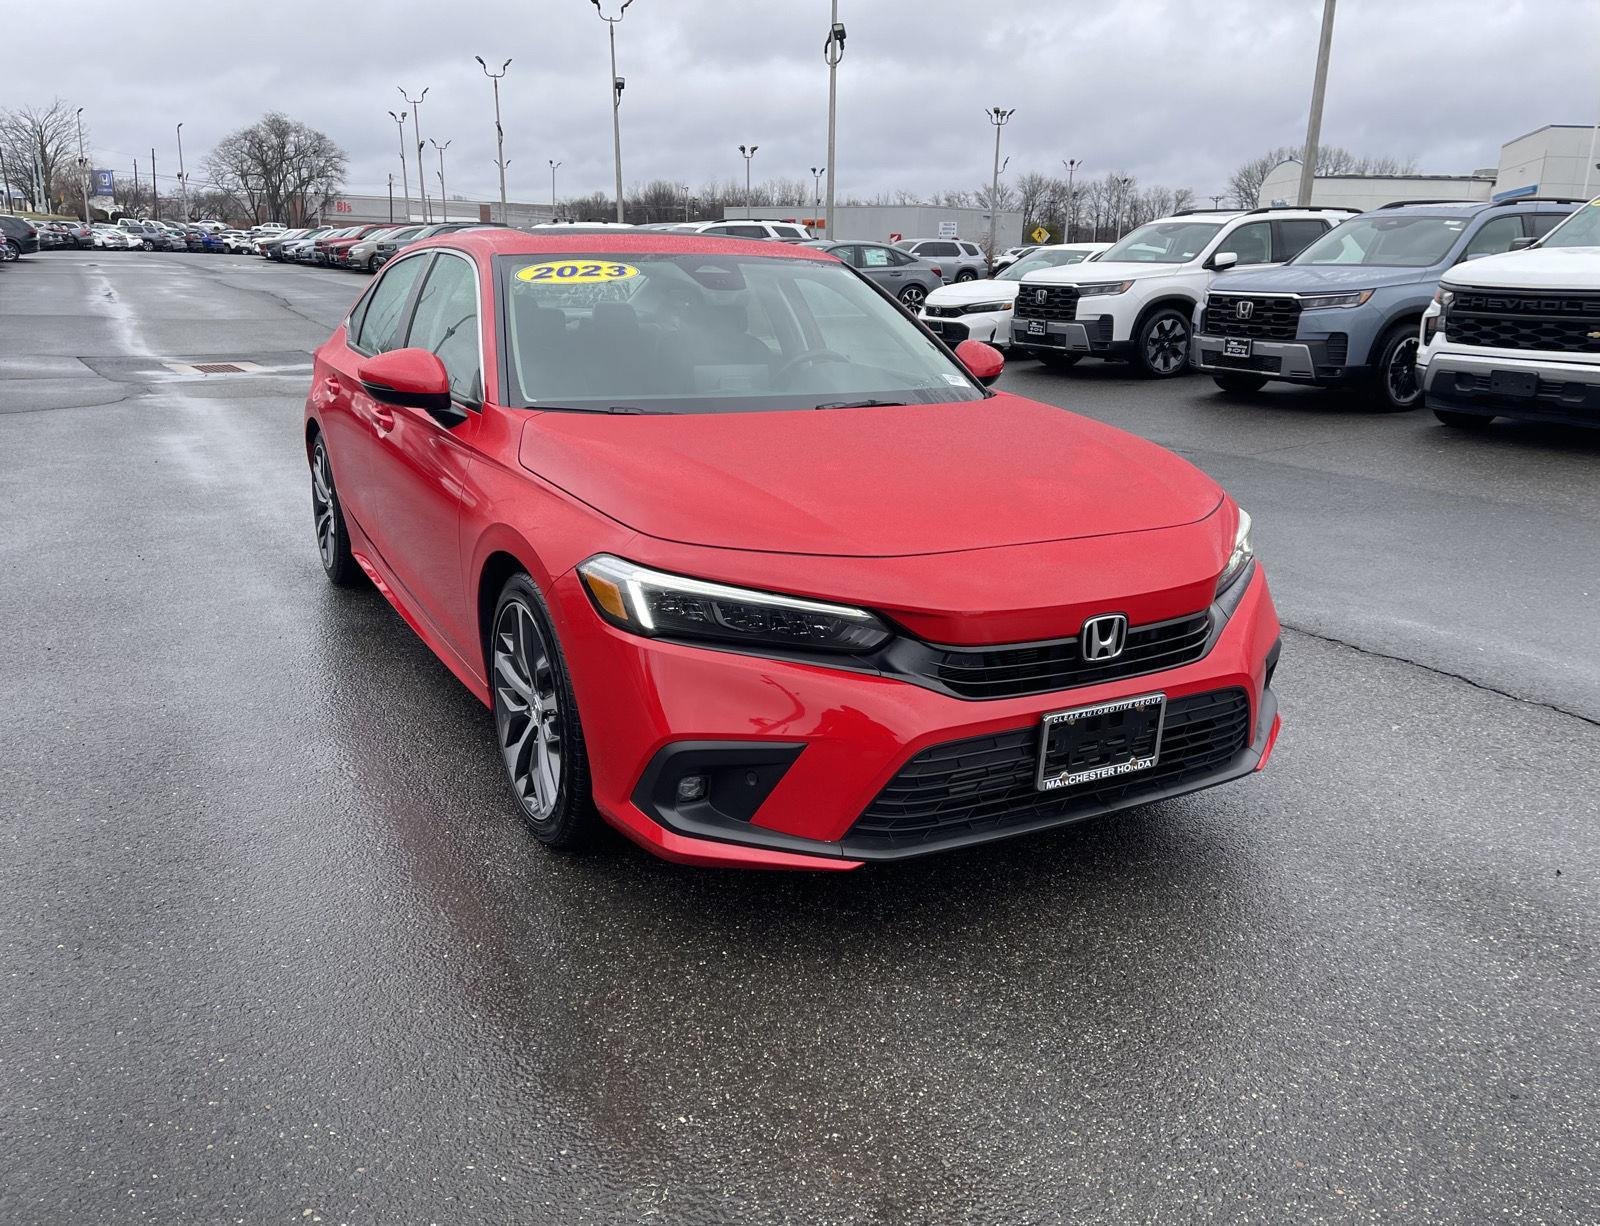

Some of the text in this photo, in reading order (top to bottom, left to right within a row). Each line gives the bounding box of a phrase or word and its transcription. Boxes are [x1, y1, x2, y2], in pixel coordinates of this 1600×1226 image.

[531, 265, 627, 280] 2023
[1053, 697, 1162, 723] CLEAR AUTOMOTIVE GROUP
